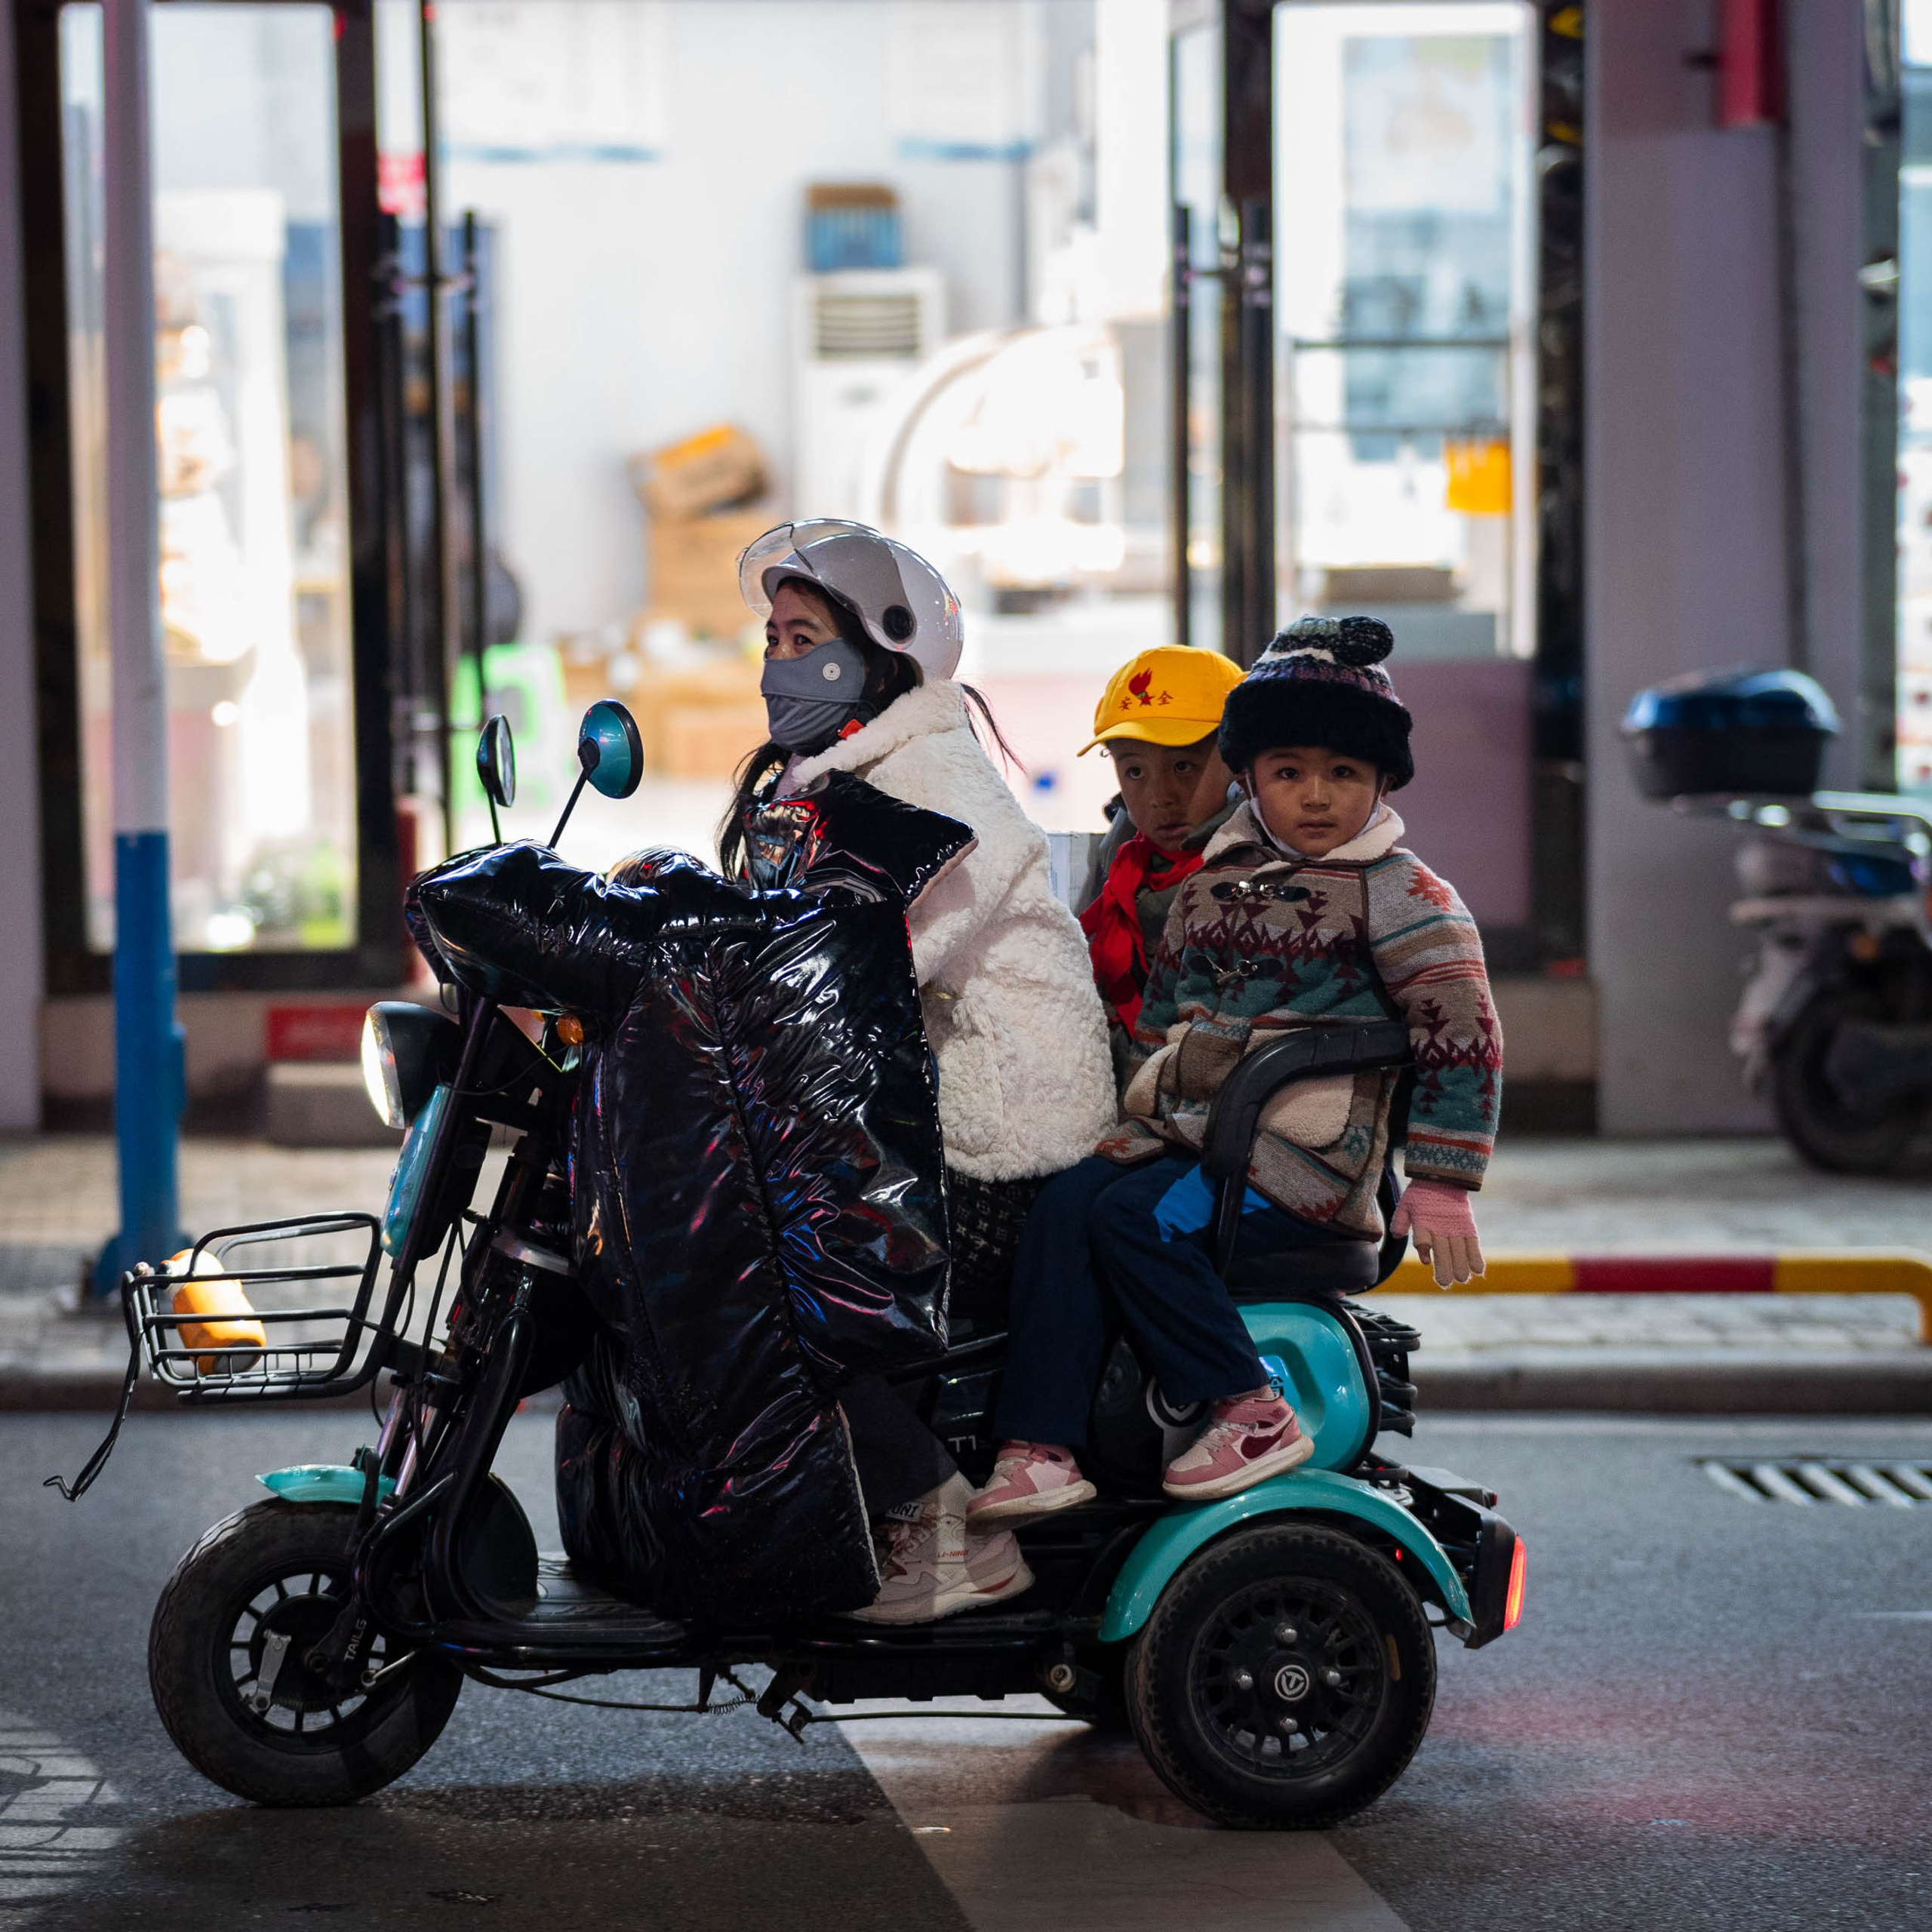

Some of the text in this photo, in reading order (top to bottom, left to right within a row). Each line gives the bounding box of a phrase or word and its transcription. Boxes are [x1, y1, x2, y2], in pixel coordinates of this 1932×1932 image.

[1118, 691, 1174, 711] 安 全
[948, 1435, 977, 1453] T1
[343, 1618, 367, 1661] TAILG
